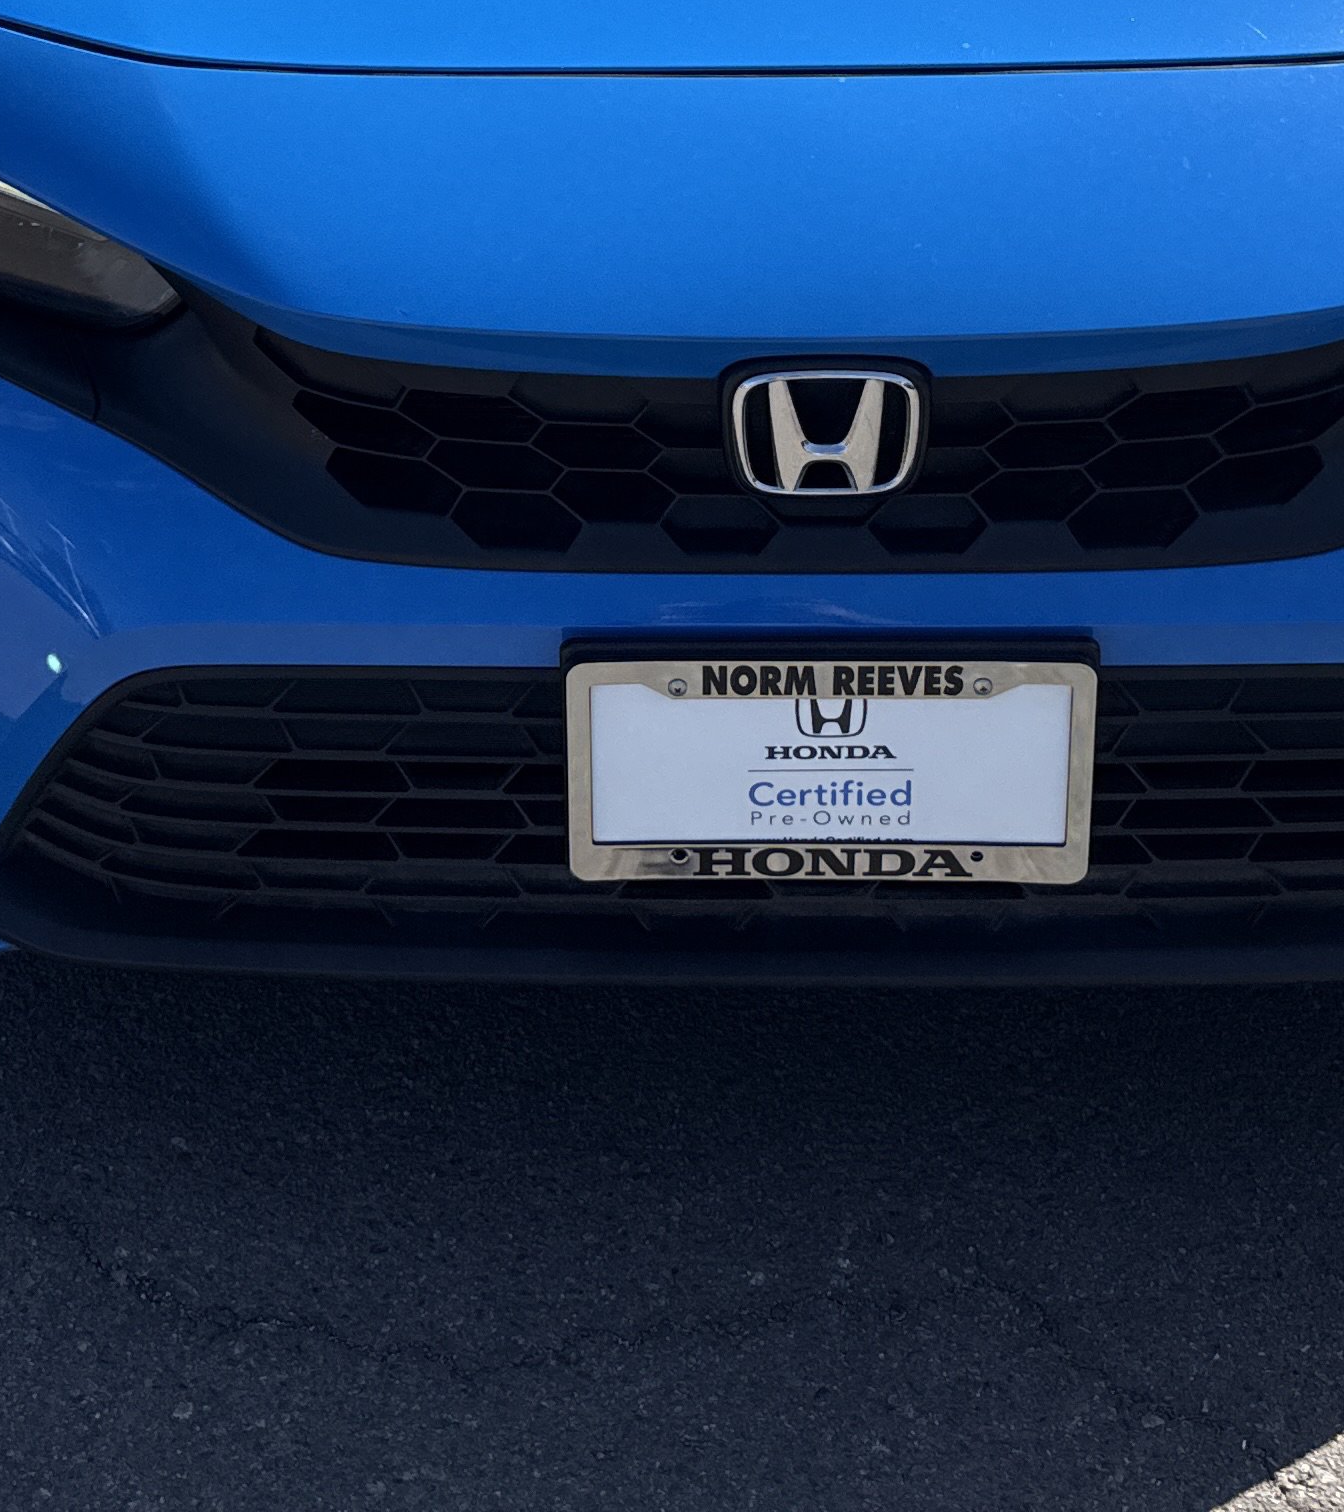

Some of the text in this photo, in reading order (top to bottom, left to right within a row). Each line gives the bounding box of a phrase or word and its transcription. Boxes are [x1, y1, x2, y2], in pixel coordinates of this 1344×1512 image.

[701, 665, 965, 696] NORM REEVES
[764, 745, 897, 760] HONDA
[748, 779, 914, 807] Certified
[750, 810, 912, 827] Pre-Owned
[693, 848, 974, 877] HONDA
